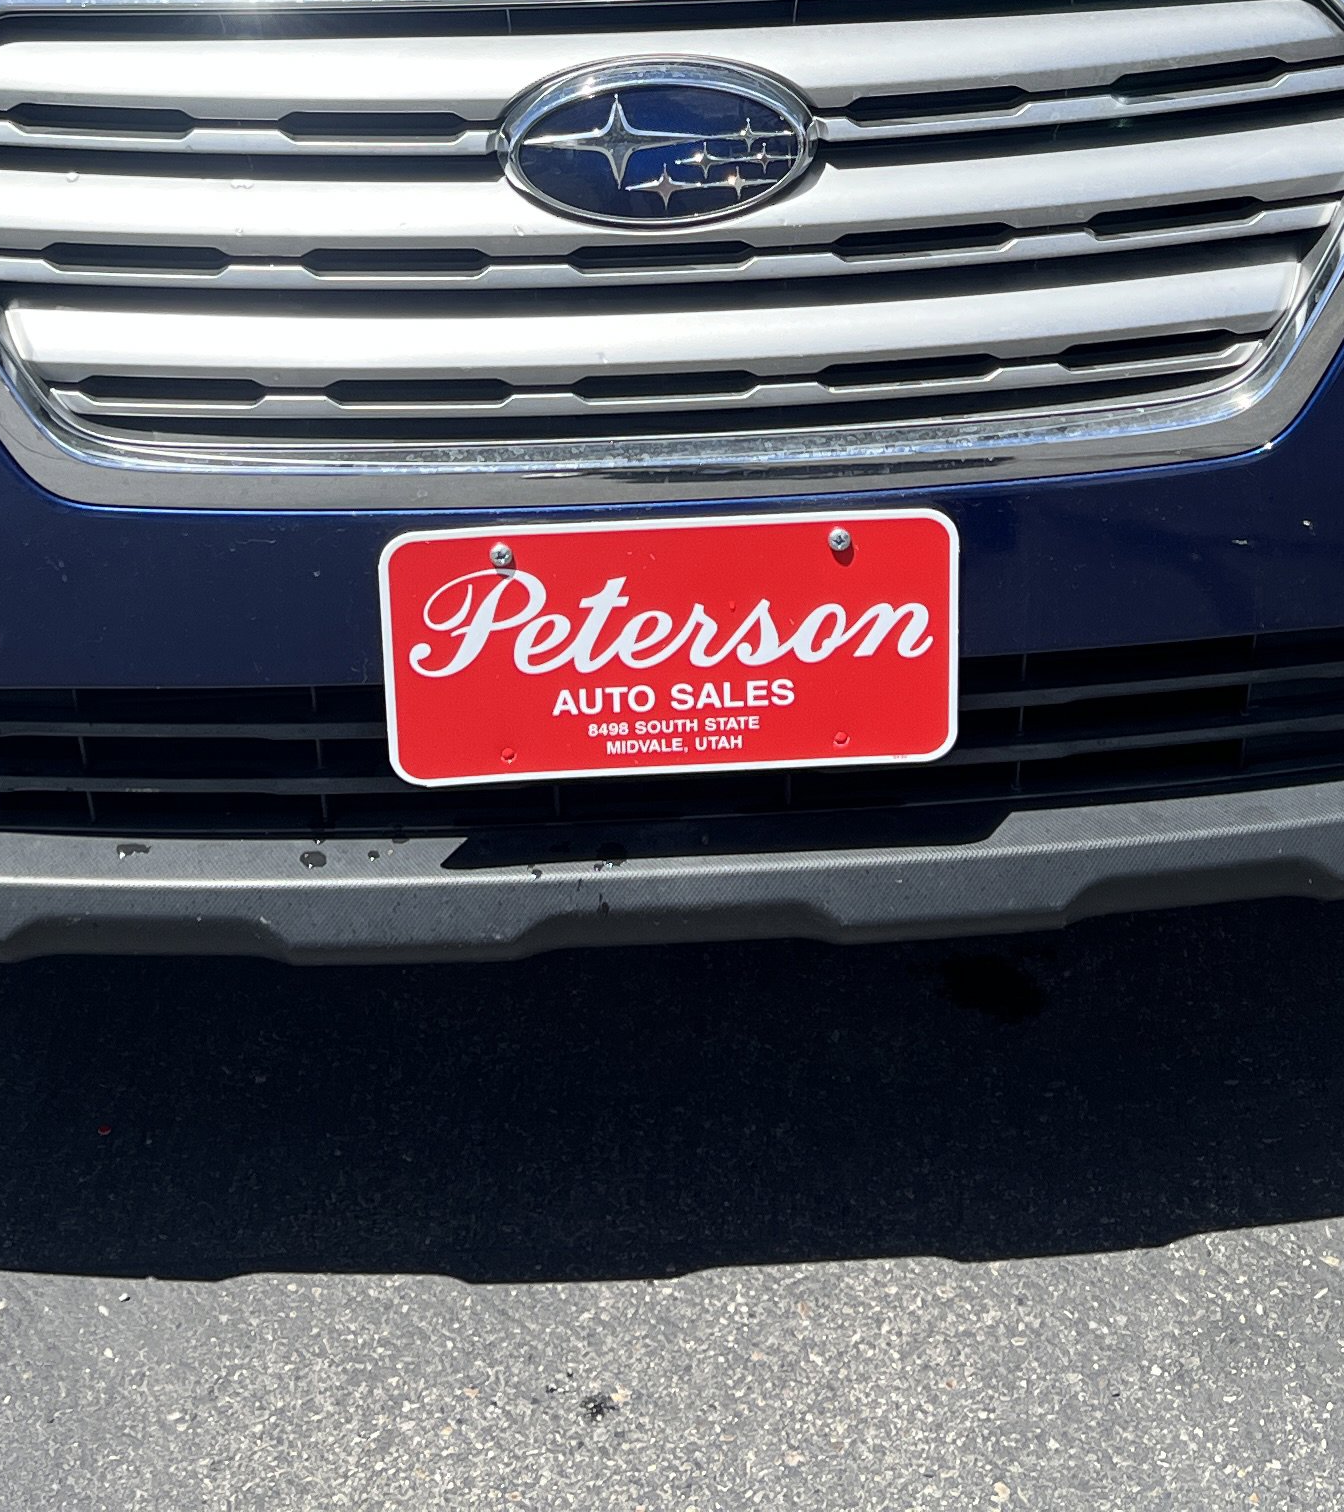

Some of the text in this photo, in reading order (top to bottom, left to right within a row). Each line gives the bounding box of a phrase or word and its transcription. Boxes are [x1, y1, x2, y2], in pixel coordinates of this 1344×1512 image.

[408, 568, 934, 678] Peterson
[552, 678, 795, 717] AUTO SALES
[588, 715, 760, 737] 8498 SOUTH STATE
[606, 735, 743, 755] MIDVALE, UTAH
